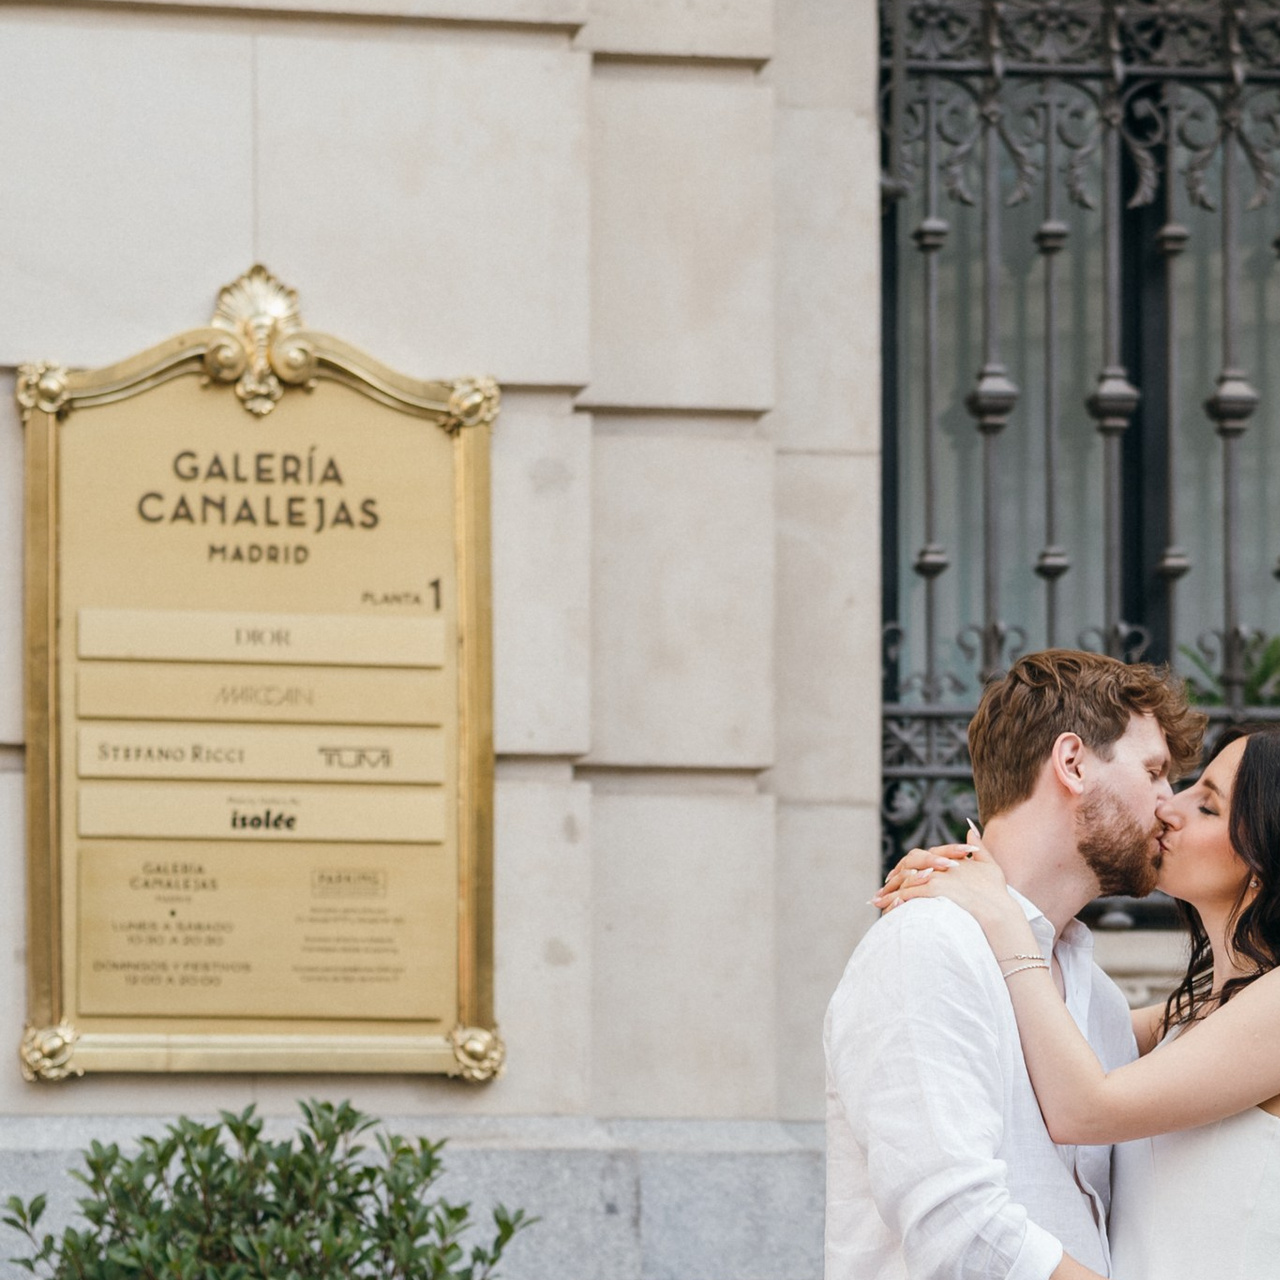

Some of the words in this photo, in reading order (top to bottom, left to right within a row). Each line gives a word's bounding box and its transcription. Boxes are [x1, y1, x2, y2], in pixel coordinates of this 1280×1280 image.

[172, 444, 345, 487] GALERÍA
[137, 491, 380, 533] CANALEJAS
[207, 543, 311, 565] MADRID
[361, 591, 421, 606] PLANTA
[428, 577, 442, 612] 1
[234, 628, 292, 647] DIOR
[98, 742, 186, 763] STEFANO
[191, 744, 245, 765] RICCI
[318, 747, 393, 769] TUMI
[230, 809, 298, 832] isolée
